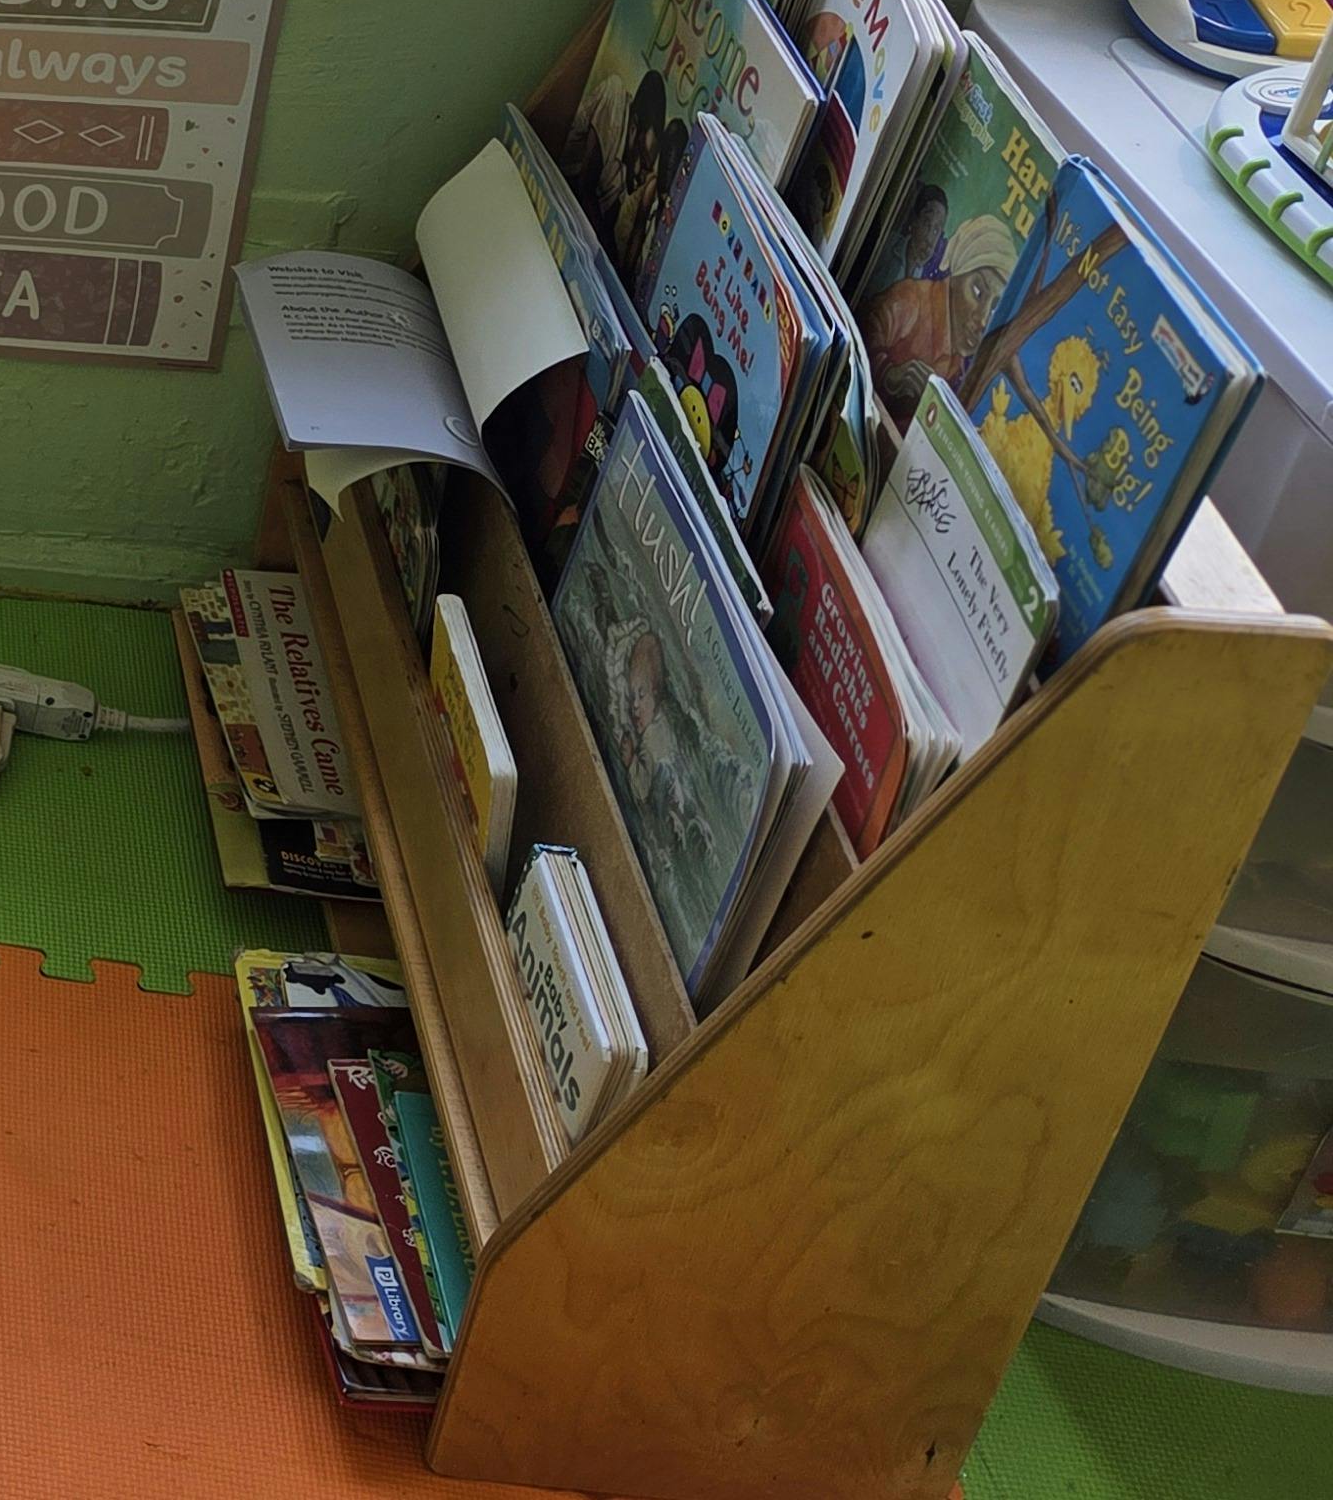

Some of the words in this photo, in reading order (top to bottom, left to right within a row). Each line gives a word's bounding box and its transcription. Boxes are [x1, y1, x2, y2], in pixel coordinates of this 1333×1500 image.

[1000, 125, 1052, 202] Har
[1000, 174, 1036, 240] Tu
[320, 306, 340, 314] the
[696, 259, 726, 338] Being
[727, 325, 755, 378] Me!
[714, 256, 726, 282] I
[724, 274, 749, 334] Like
[1053, 211, 1082, 258] It's
[1077, 244, 1109, 295] Not
[1106, 285, 1144, 357] Easy
[1116, 366, 1174, 469] Being
[1103, 427, 1153, 513] Big!
[617, 437, 708, 647] Hush!
[267, 584, 296, 625] The
[946, 550, 978, 618] Lonely
[977, 612, 1010, 683] Firefly
[968, 544, 988, 588] The
[988, 584, 1011, 636] Very
[1022, 585, 1040, 620] 2
[279, 631, 326, 733] Relatives
[814, 602, 868, 730] Radishes
[821, 582, 875, 708] Growing
[808, 628, 833, 684] and
[832, 681, 875, 790] Carrots
[310, 737, 345, 797] Came
[511, 909, 581, 1112] Animals
[543, 963, 568, 1032] Baby
[382, 1287, 410, 1341] Library
